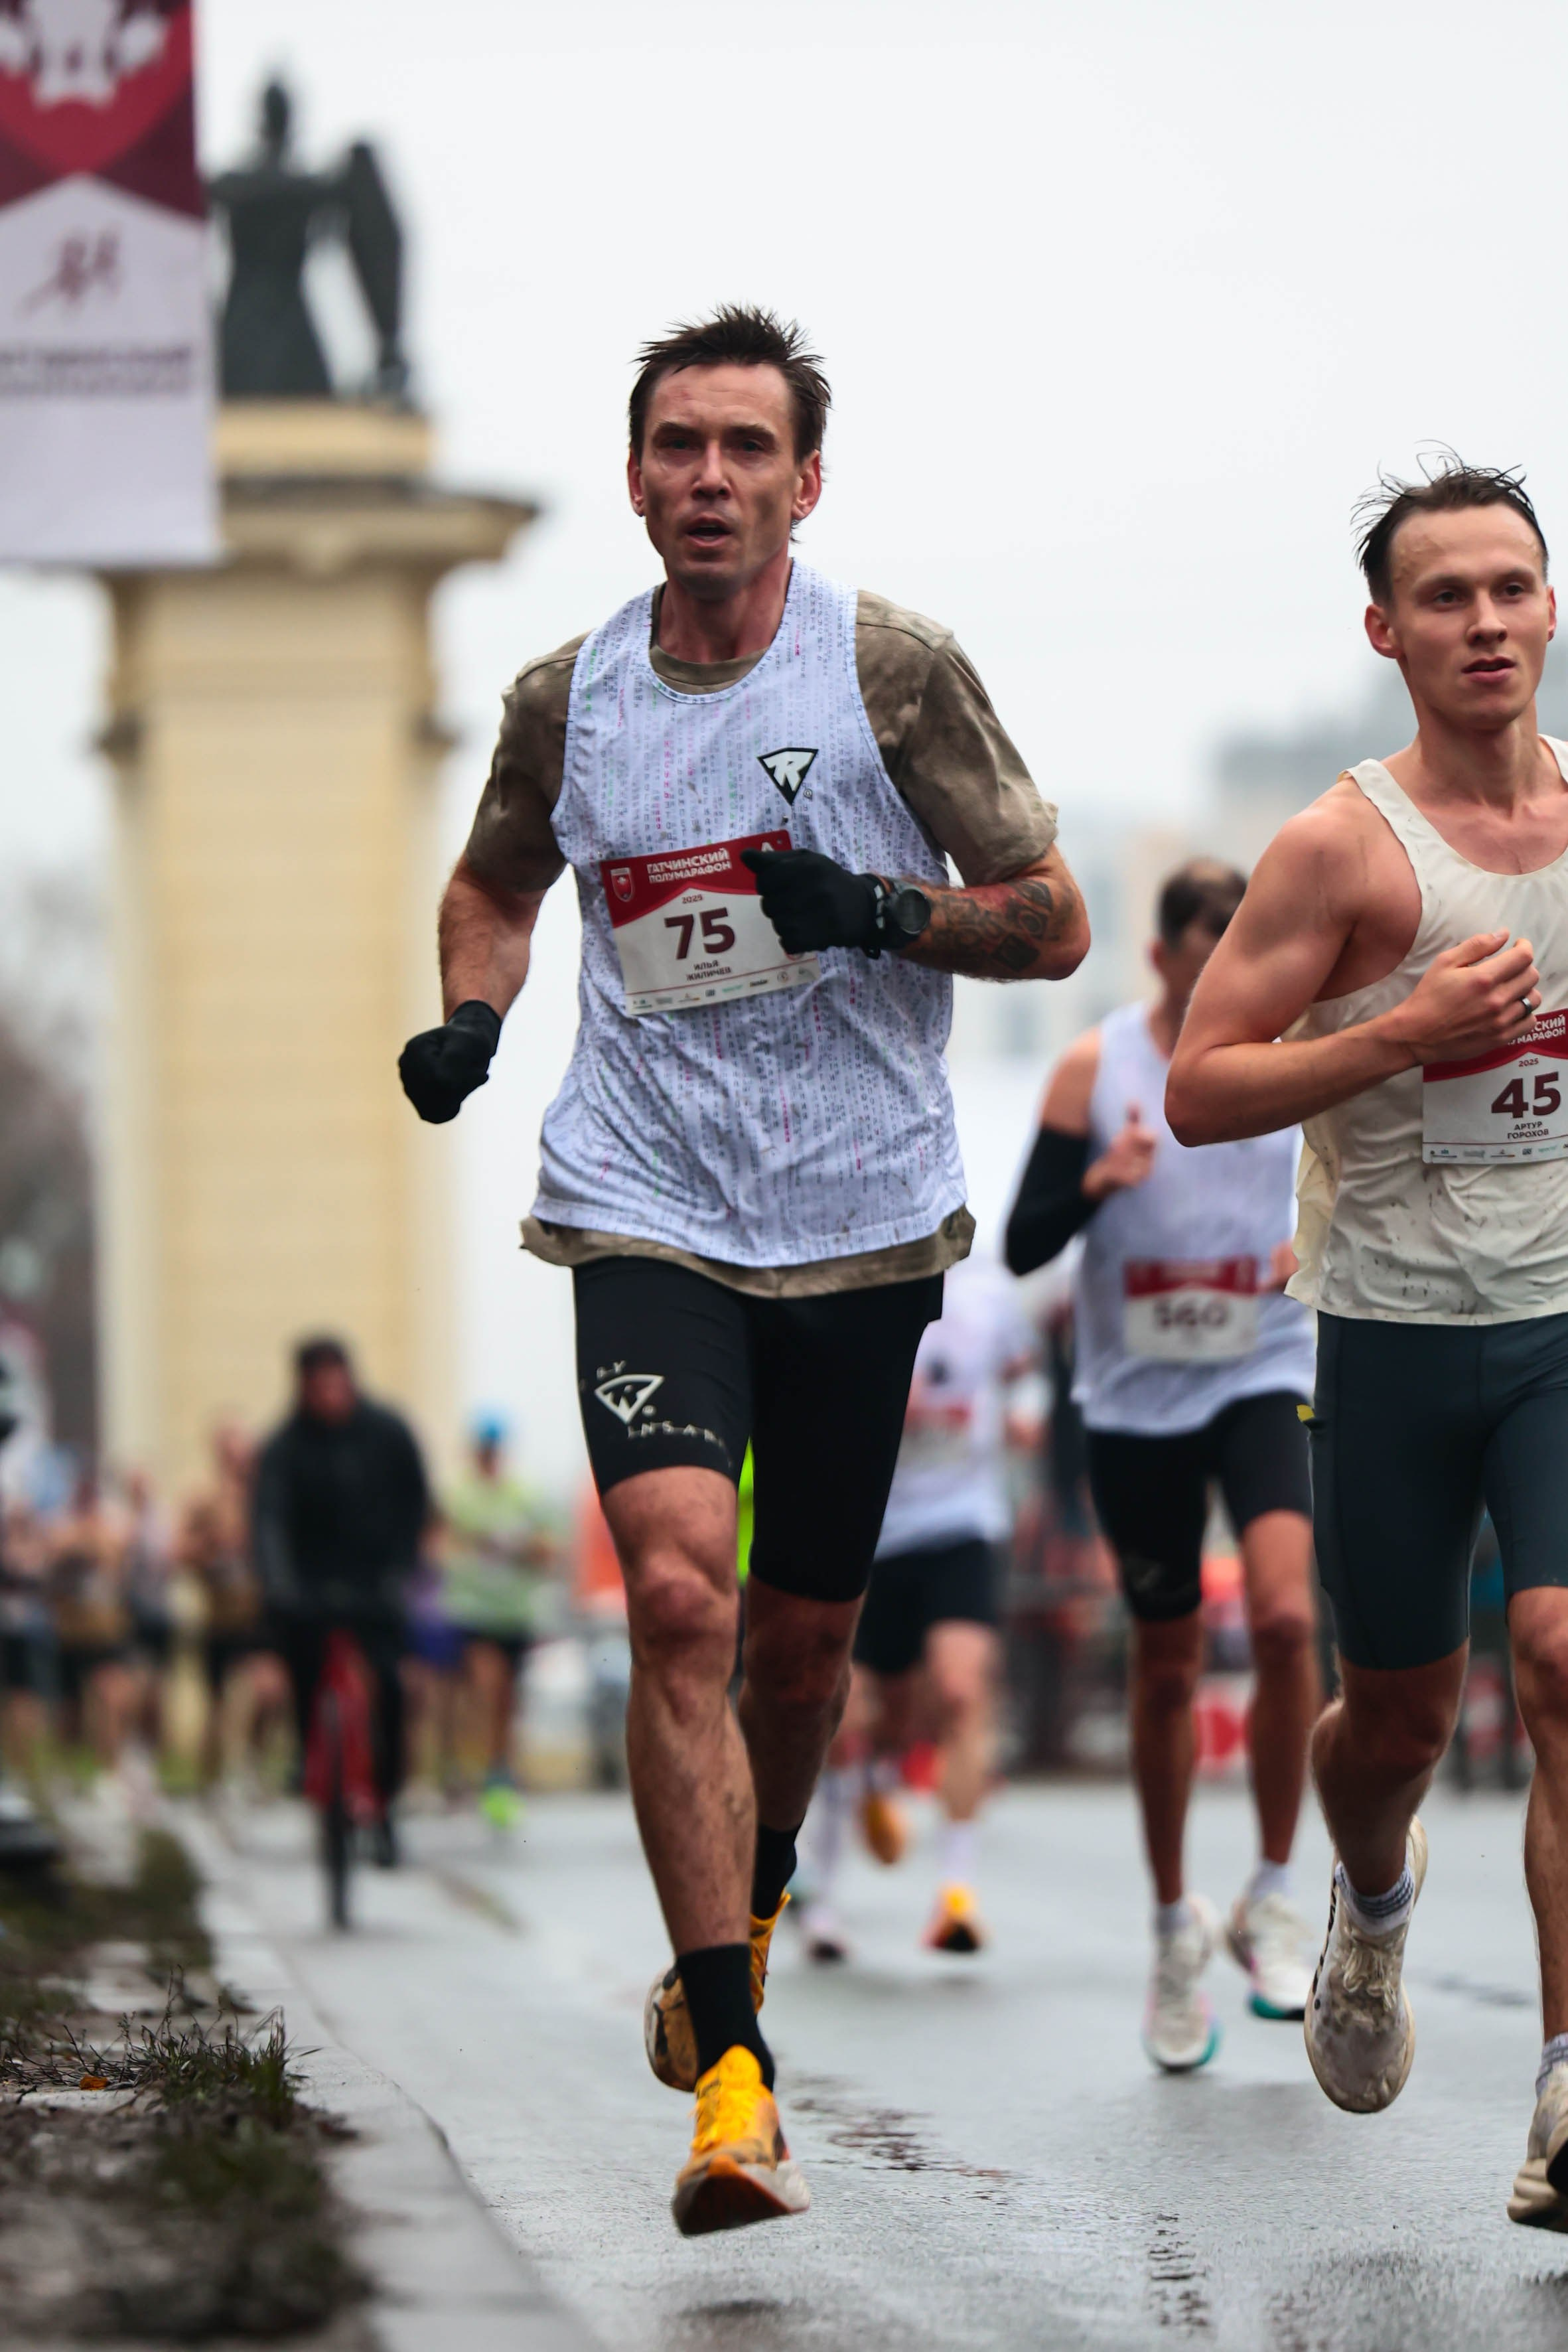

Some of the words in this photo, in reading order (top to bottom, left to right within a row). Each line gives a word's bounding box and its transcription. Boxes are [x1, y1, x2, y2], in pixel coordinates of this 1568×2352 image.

[646, 847, 730, 874] ГАТЧИНСКИЙ
[649, 861, 733, 883] ПОЛУМАРАФОН
[681, 894, 703, 905] 2025
[665, 907, 737, 960] 75
[693, 960, 719, 971] ИЛЬЯ
[1532, 1014, 1565, 1033] СКИЙ
[1507, 1027, 1565, 1045] МАРАФОН
[1518, 1057, 1539, 1067] 2025
[1490, 1070, 1562, 1119] 45
[1507, 1128, 1549, 1139] ГОРОХОВ
[1514, 1121, 1543, 1131] АРТУР
